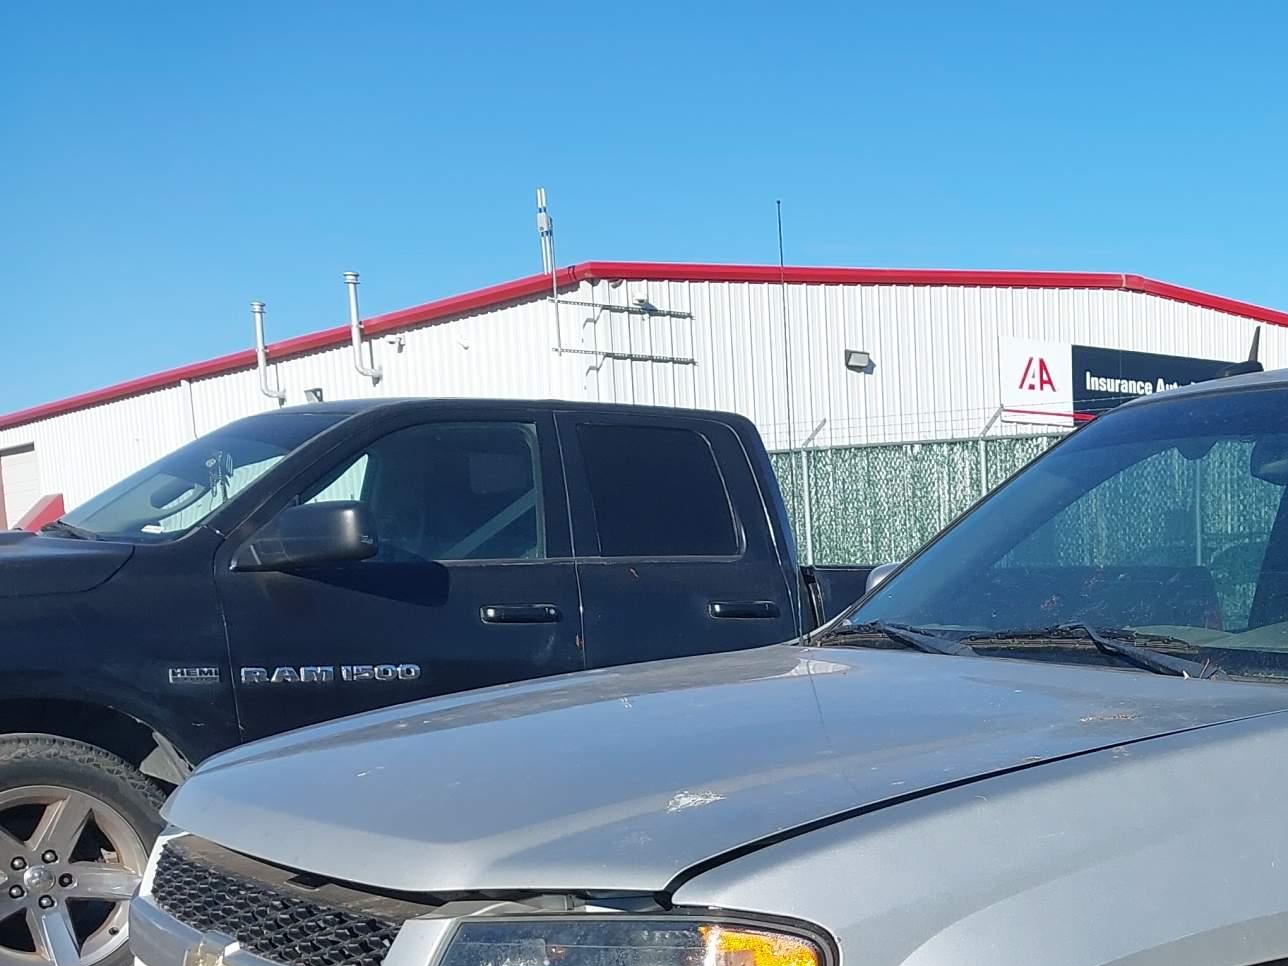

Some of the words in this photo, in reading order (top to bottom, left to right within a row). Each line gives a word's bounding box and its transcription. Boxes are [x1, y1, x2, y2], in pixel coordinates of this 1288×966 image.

[1086, 372, 1153, 395] Insurance
[1156, 378, 1188, 394] Au
[169, 666, 219, 678] HEMI
[240, 667, 334, 684] RAM
[341, 664, 420, 681] 1500
